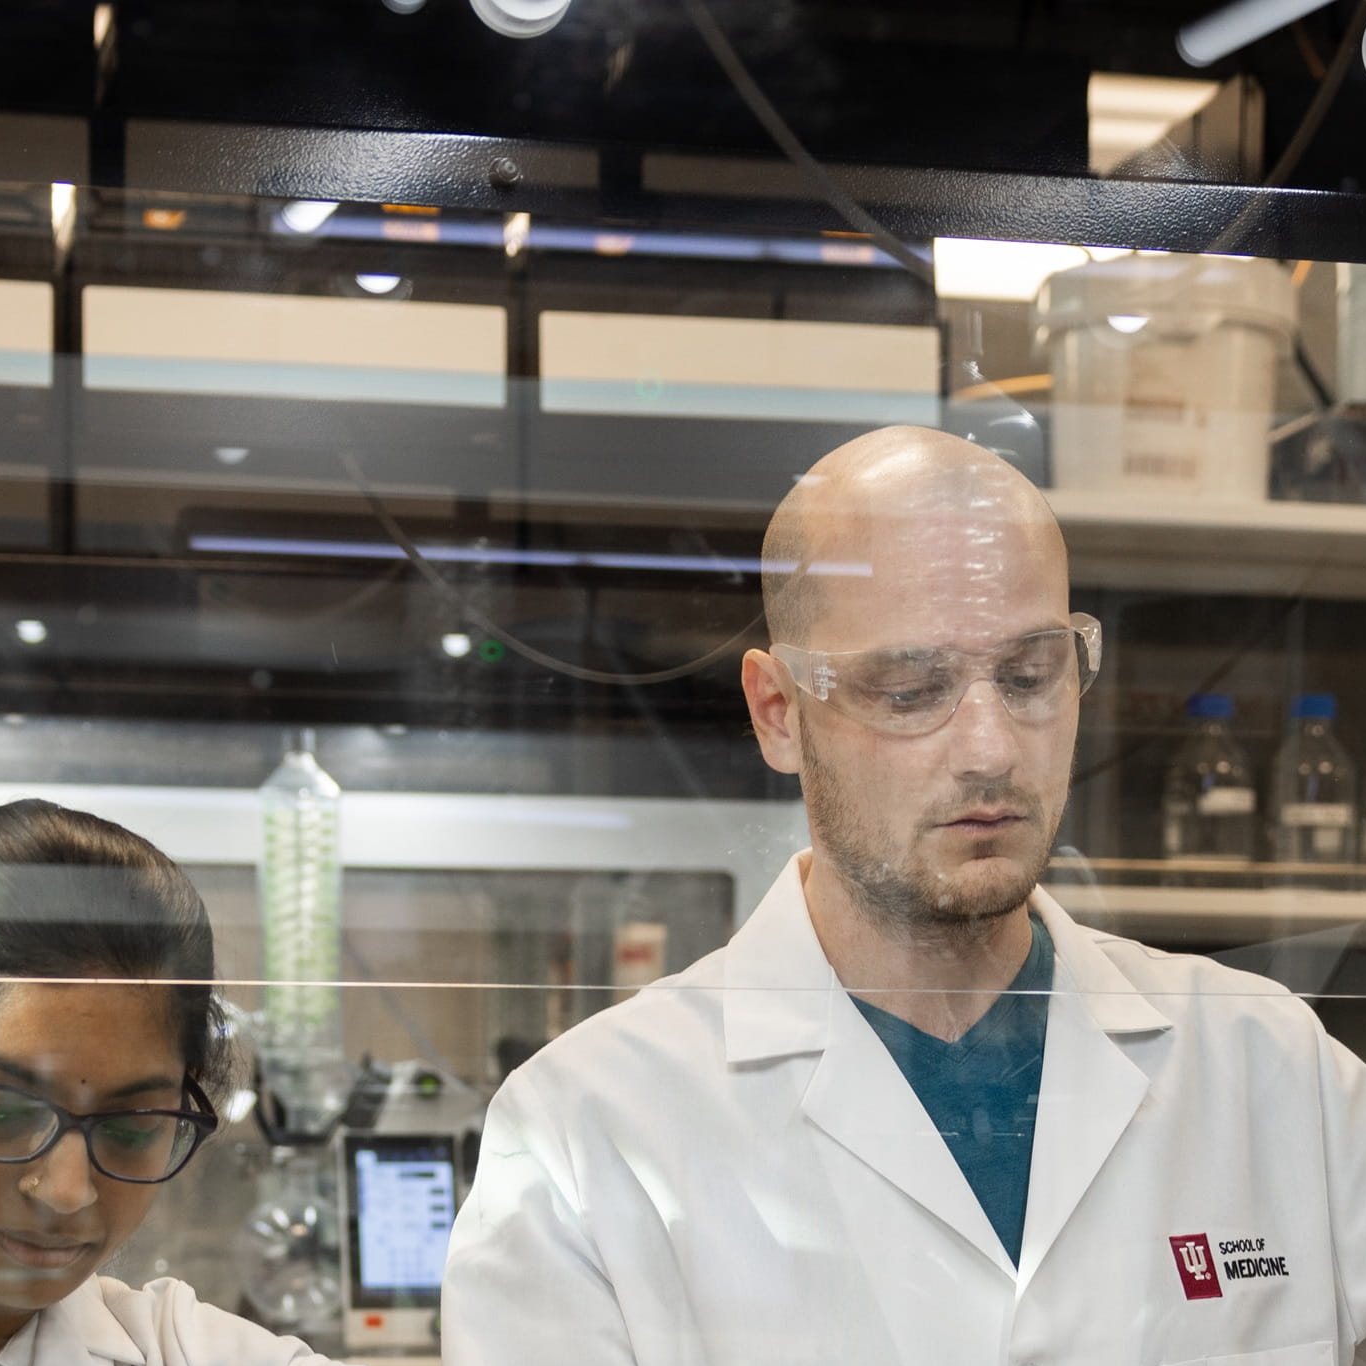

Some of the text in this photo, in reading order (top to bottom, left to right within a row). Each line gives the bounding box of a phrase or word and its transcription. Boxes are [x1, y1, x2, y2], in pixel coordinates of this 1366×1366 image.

[1218, 1238, 1266, 1255] SCHOOL OF
[1223, 1256, 1290, 1280] MEDICINE
